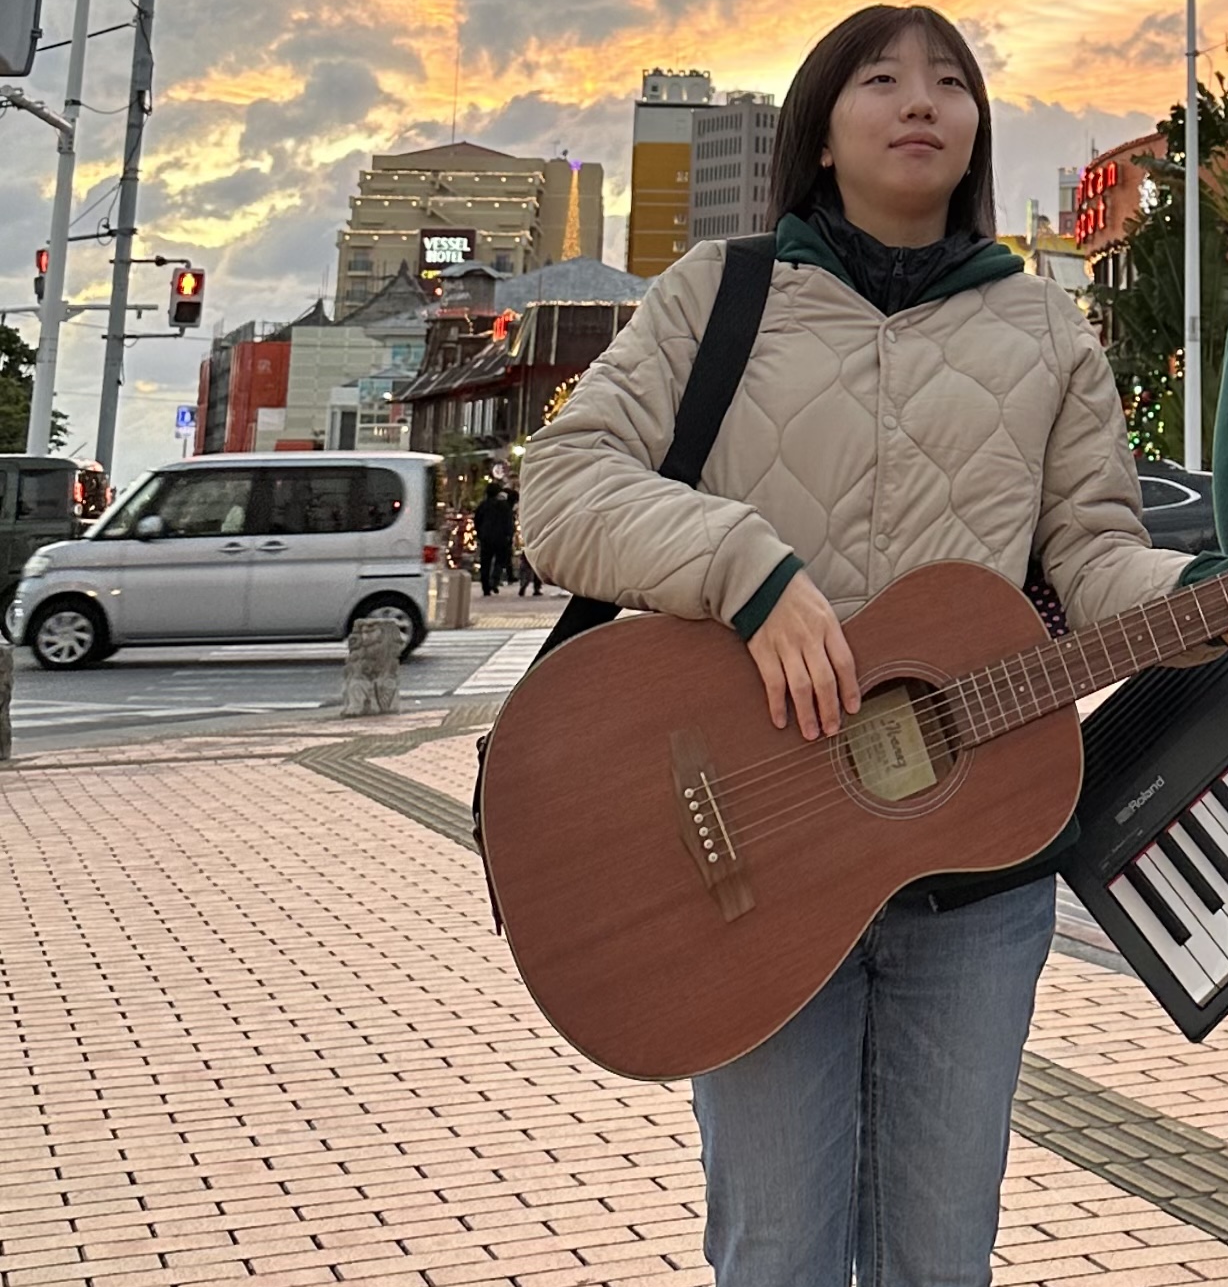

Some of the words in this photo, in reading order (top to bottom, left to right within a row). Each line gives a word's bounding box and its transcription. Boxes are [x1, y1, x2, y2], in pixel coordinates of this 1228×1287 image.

[422, 236, 471, 252] VESSEL
[425, 250, 465, 263] HOTEL
[1128, 775, 1165, 812] Roland
